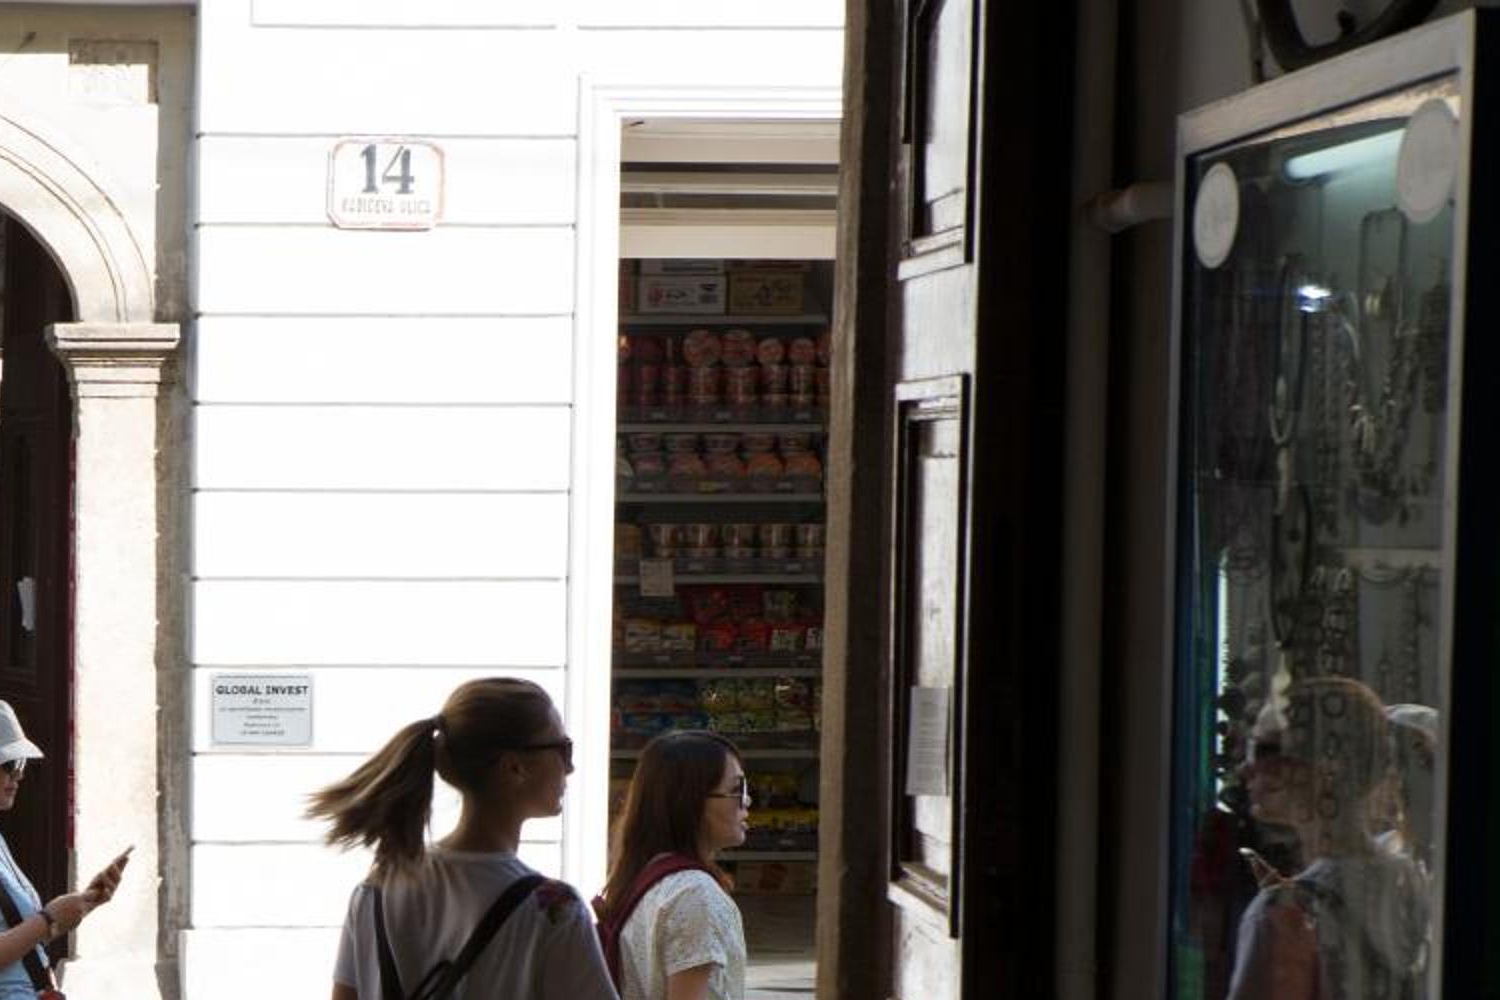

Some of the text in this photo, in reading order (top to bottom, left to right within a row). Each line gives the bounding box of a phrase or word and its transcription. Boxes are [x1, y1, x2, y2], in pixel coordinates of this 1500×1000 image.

[360, 144, 415, 194] 14
[215, 685, 308, 695] GLOBAL INVEST
